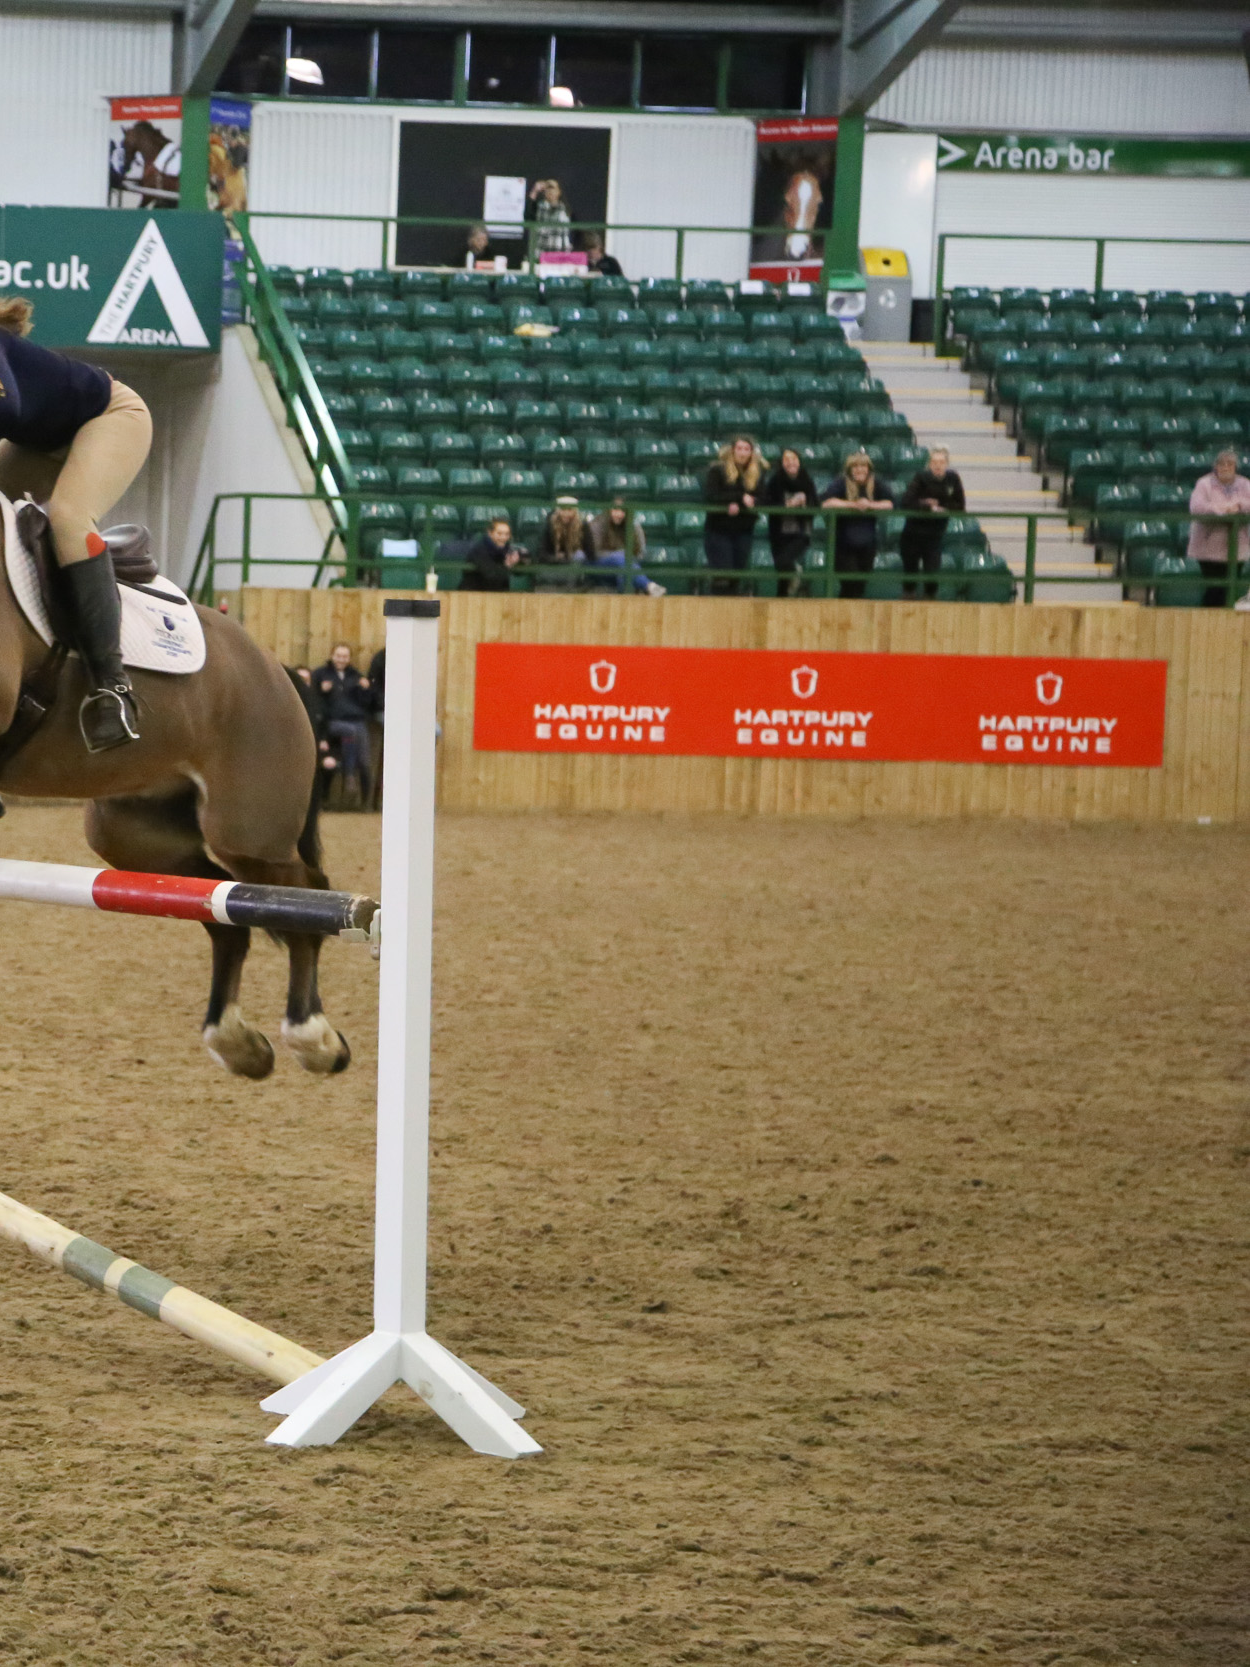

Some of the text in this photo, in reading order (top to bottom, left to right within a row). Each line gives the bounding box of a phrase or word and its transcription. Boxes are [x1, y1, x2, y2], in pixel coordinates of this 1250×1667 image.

[973, 141, 1115, 171] Arena bar
[114, 235, 158, 310] HARTPURY
[118, 327, 180, 346] ARENA
[533, 703, 671, 723] HARTPURY
[733, 708, 874, 728] HARTPURY
[535, 723, 666, 742] EQUINE
[979, 714, 1118, 734] HARTPURY
[736, 727, 867, 748] EQUINE
[981, 733, 1112, 754] EQUINE
